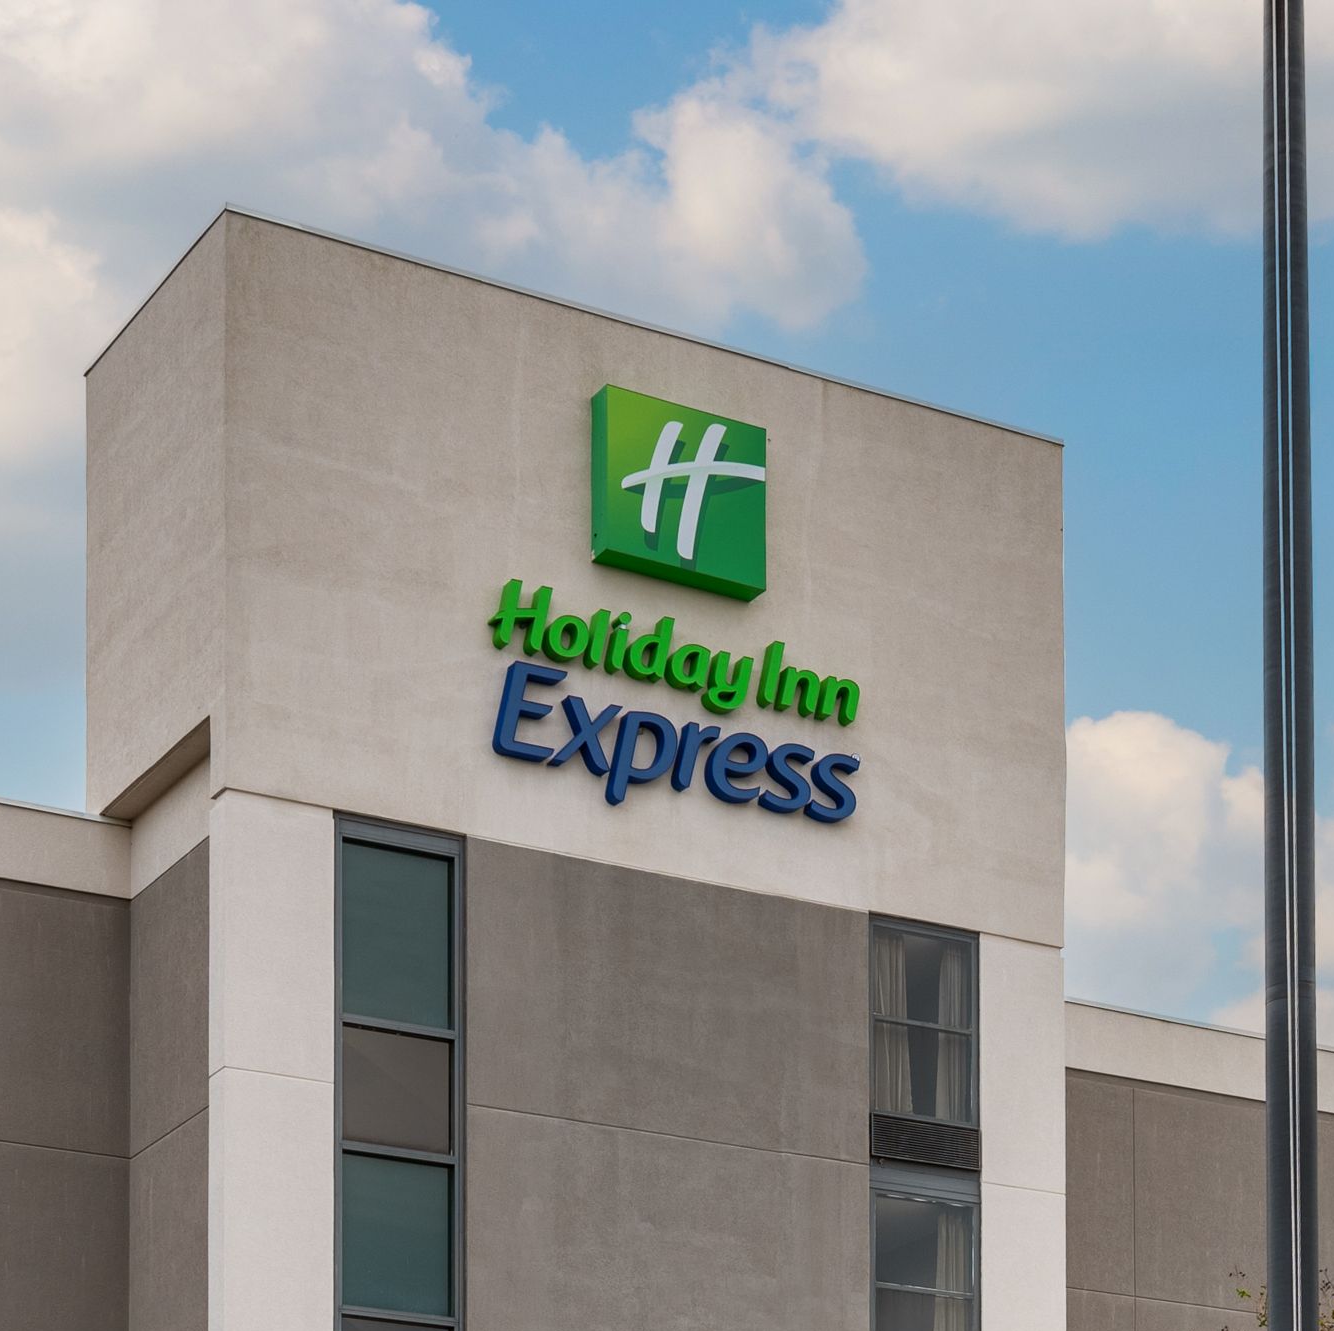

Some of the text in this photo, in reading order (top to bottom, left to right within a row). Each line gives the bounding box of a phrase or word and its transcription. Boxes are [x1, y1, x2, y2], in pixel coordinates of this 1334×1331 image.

[488, 578, 860, 727] Holiday Inn
[492, 660, 860, 824] Express
